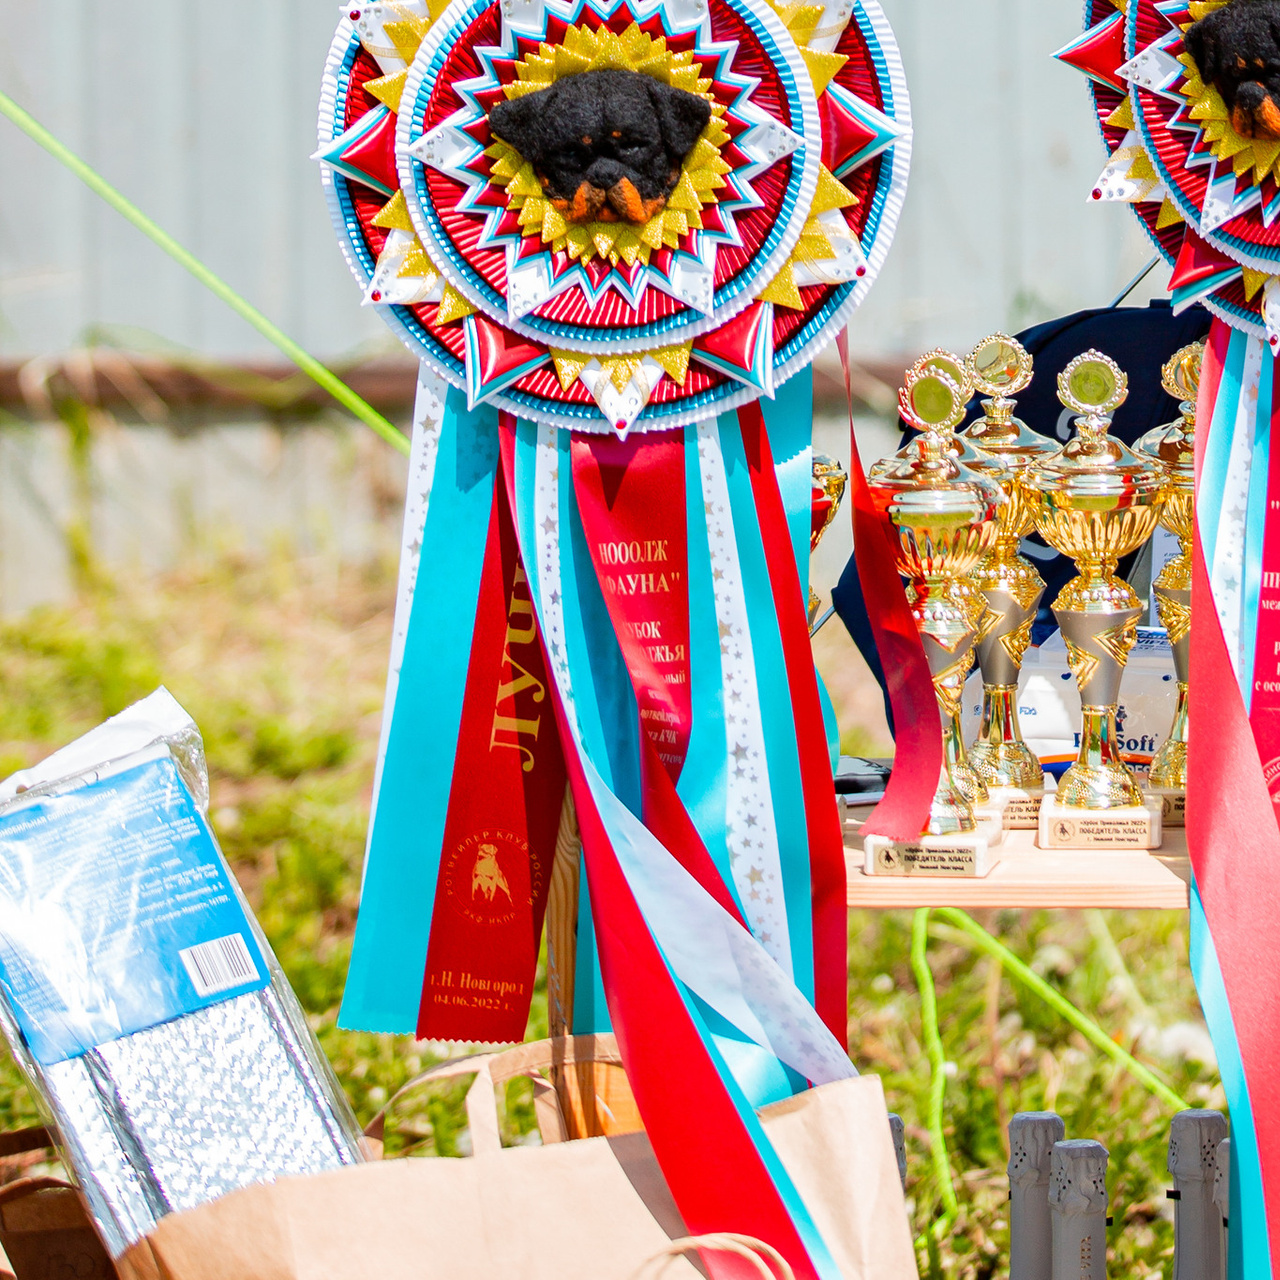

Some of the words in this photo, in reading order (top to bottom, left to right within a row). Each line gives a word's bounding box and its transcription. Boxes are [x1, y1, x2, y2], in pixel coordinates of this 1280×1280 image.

[598, 540, 668, 565] НОООЛЖ
[1255, 681, 1260, 691] с
[497, 831, 528, 851] КЛУБ
[527, 853, 543, 906] РОССИИ
[434, 994, 501, 1011] 04.06.2022
